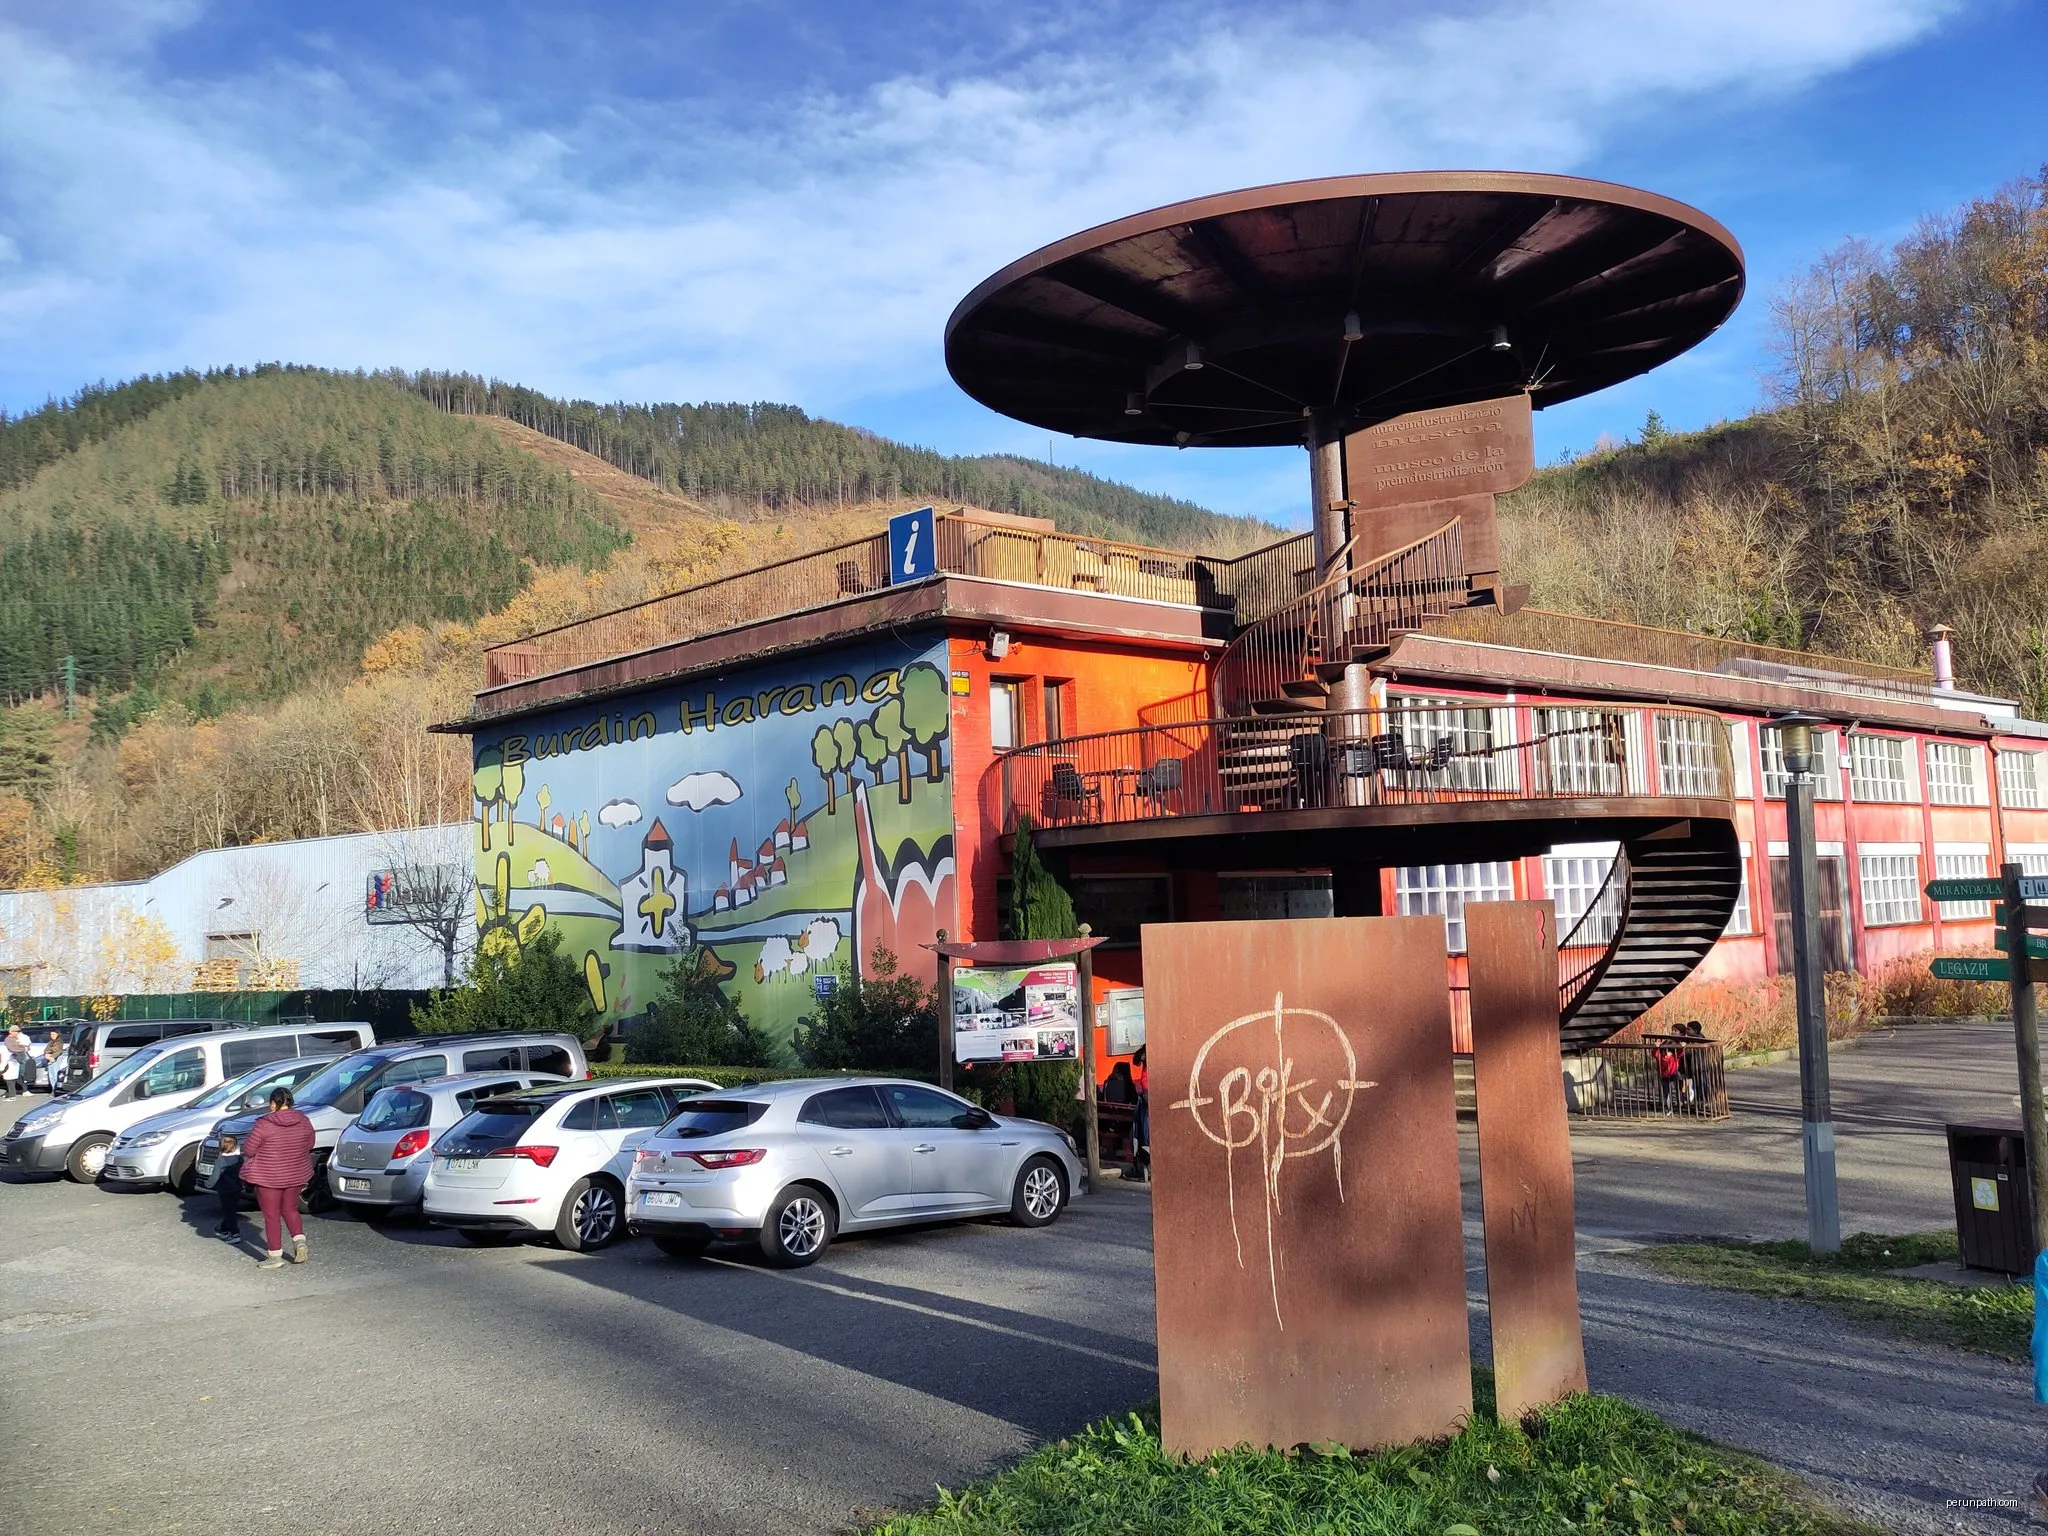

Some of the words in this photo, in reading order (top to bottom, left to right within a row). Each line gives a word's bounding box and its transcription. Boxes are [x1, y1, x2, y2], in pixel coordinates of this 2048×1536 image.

[1373, 421, 1503, 450] museoa
[1374, 456, 1443, 474] museo
[1451, 449, 1480, 464] de
[1485, 446, 1505, 458] la
[1376, 462, 1504, 490] preindustrialización
[501, 711, 657, 767] Burdin
[679, 668, 901, 734] Harana
[1933, 883, 2002, 896] MIRANDAOLA
[1940, 961, 1989, 976] LEGAZPI
